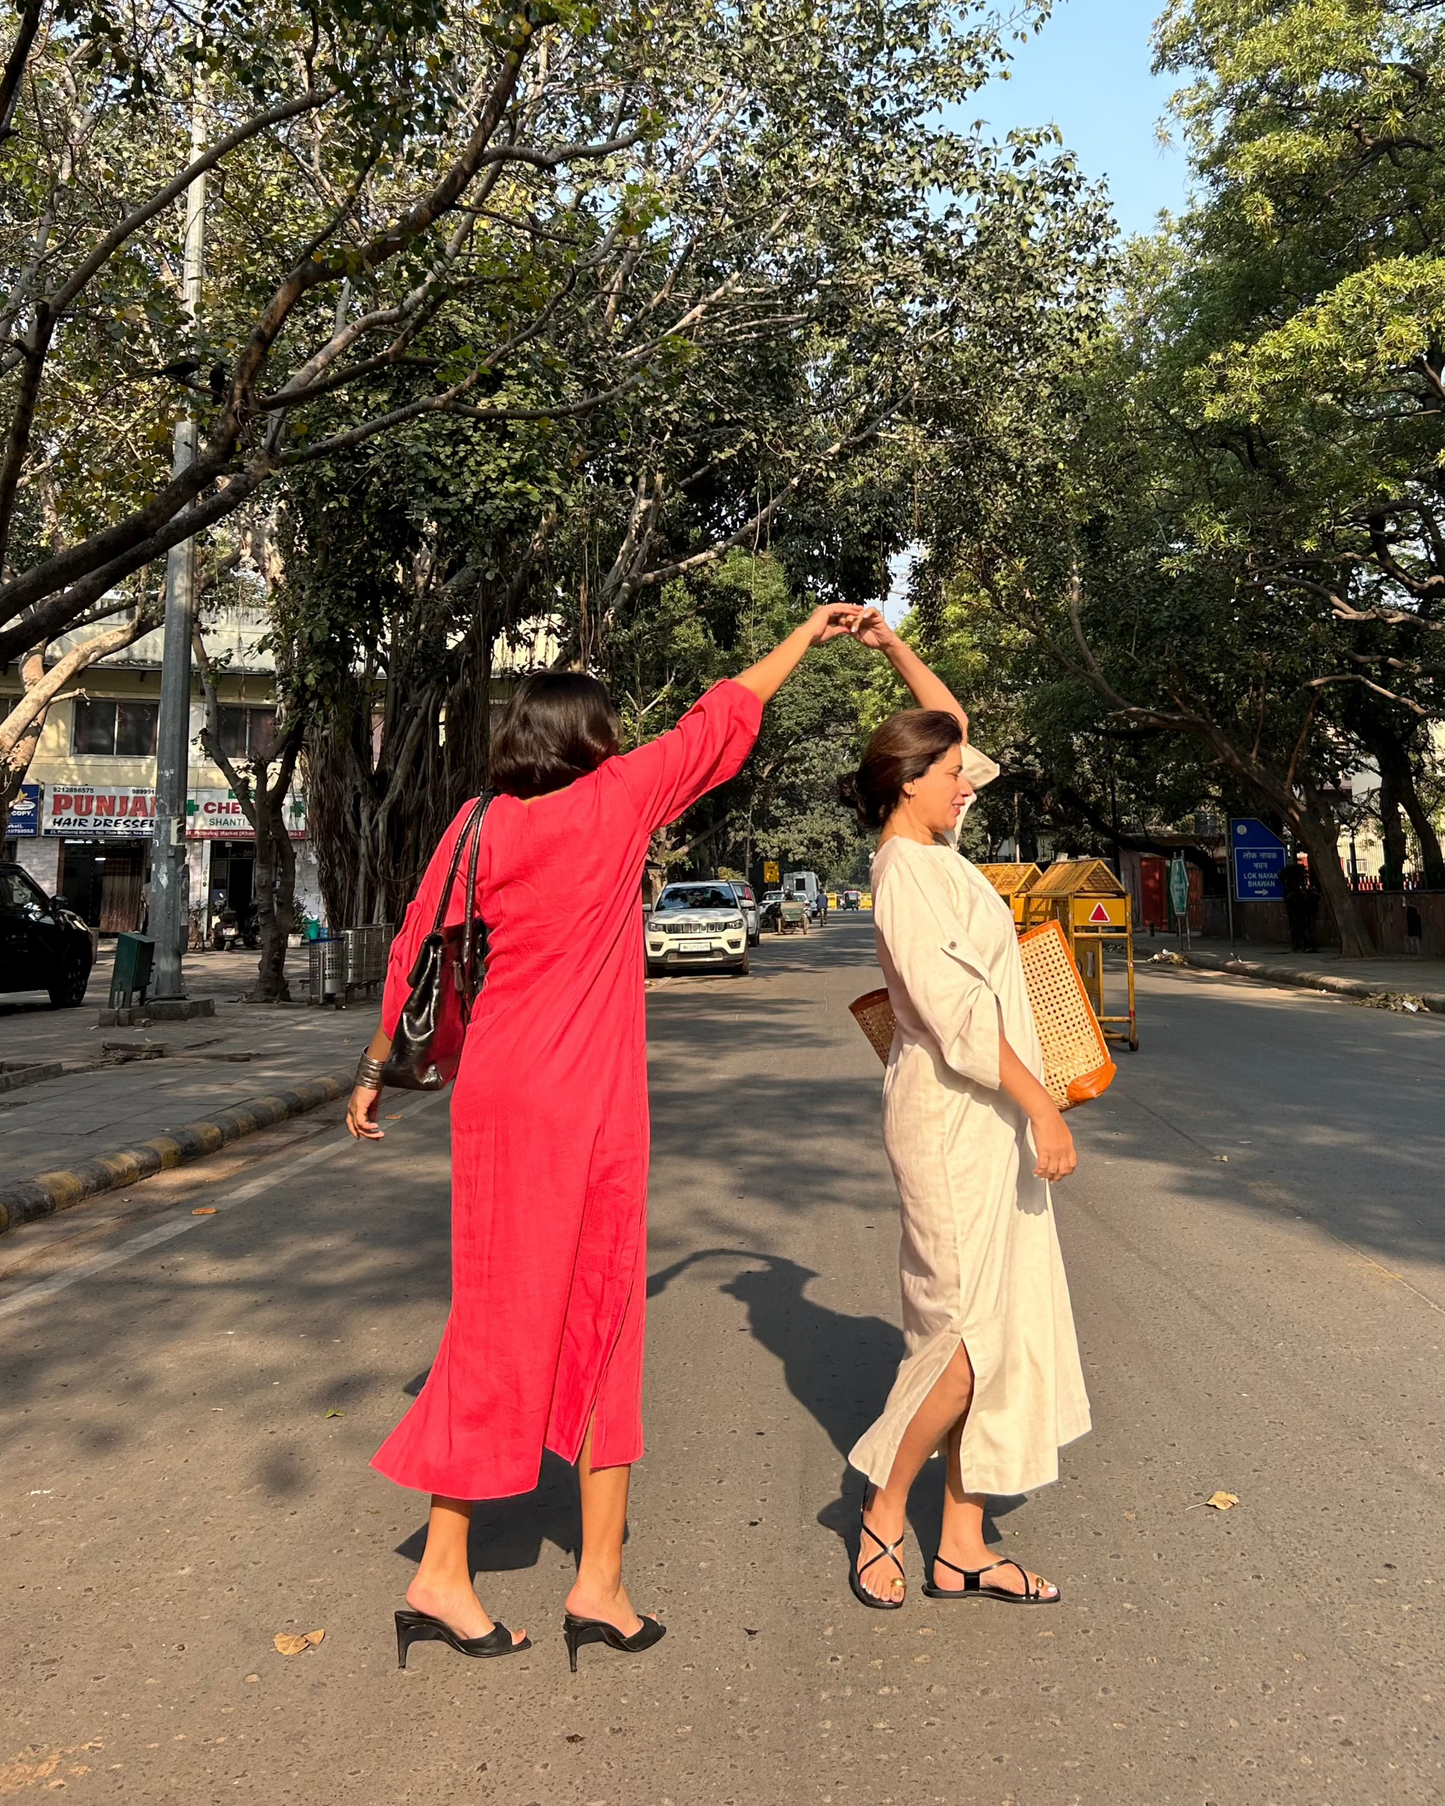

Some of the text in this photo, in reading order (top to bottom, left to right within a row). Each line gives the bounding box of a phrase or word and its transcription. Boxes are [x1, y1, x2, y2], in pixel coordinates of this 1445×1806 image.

[52, 817, 88, 828] HAIR
[209, 818, 245, 826] SHANTI
[1243, 850, 1257, 859] लोक
